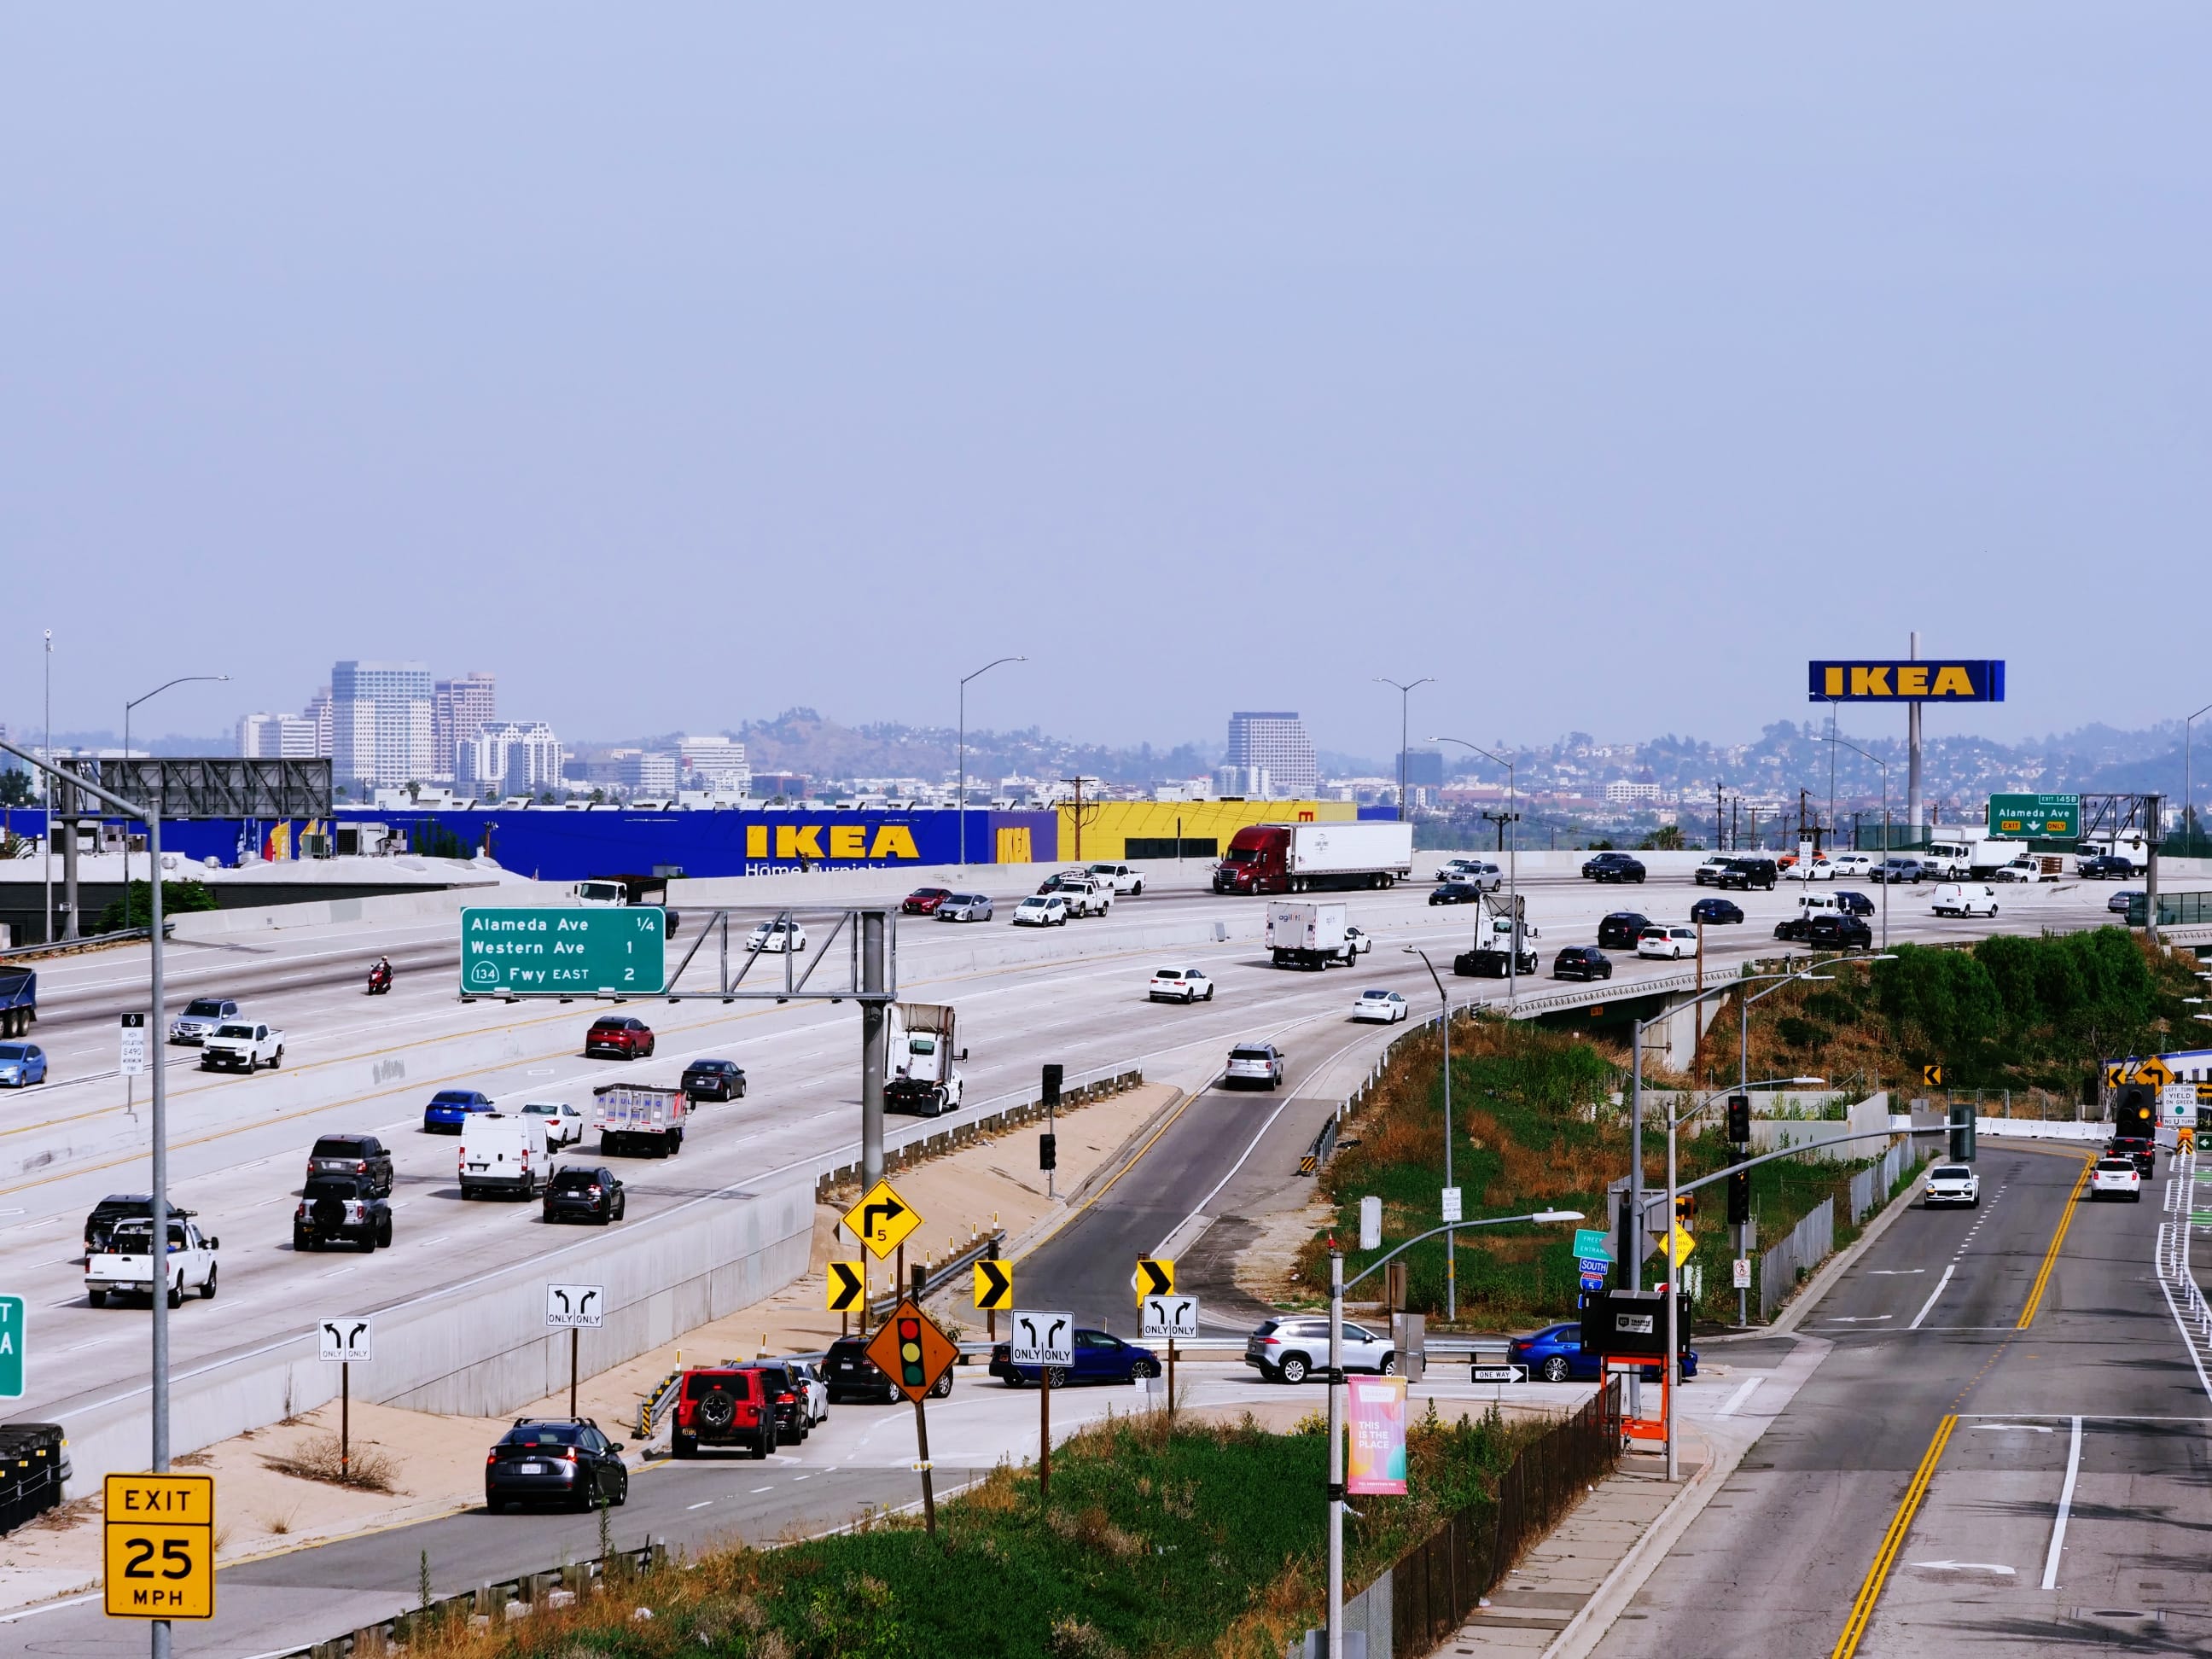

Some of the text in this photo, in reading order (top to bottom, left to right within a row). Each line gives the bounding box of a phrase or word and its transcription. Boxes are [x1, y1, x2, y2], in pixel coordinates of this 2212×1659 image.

[1825, 667, 1976, 696] IKEA
[1999, 808, 2070, 818] Alameda Ave
[746, 825, 921, 859] IKEA
[470, 917, 548, 932] Alameda
[556, 917, 590, 932] Ave
[470, 940, 633, 955] Western Ave 1
[475, 967, 635, 984] 134 Fwy EAST 2
[877, 1229, 887, 1242] 5
[1580, 1246, 1609, 1255] ENTRAN
[1581, 1260, 1607, 1272] SOUTH
[548, 1314, 601, 1324] ONLY ONLY
[1144, 1325, 1196, 1336] ONLY ONLY
[348, 1350, 368, 1359] ONLY
[1014, 1348, 1071, 1362] ONLY ONLY
[1358, 1421, 1380, 1430] THIS
[1359, 1430, 1390, 1440] IS THE
[1359, 1440, 1390, 1449] PLACE
[125, 1489, 191, 1511] EXIT
[124, 1537, 193, 1580] 25
[133, 1589, 183, 1606] MPH
